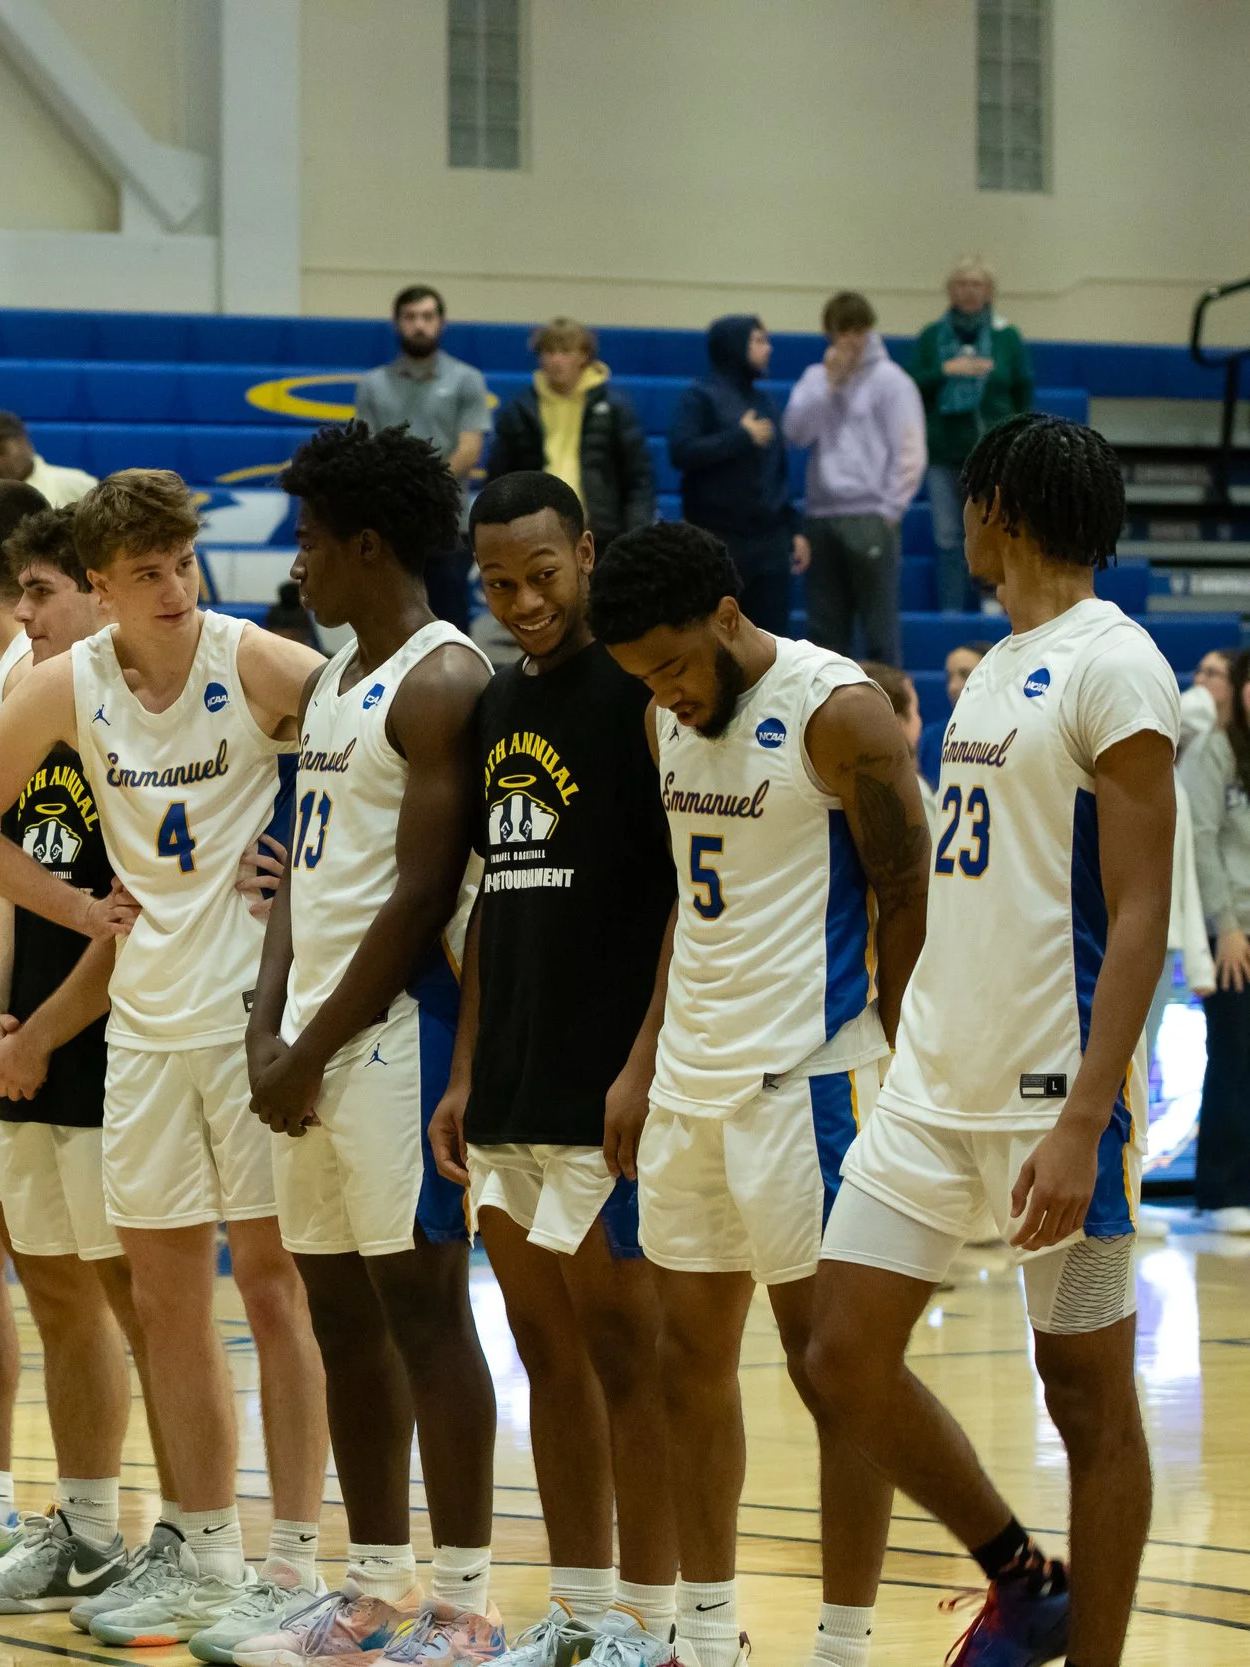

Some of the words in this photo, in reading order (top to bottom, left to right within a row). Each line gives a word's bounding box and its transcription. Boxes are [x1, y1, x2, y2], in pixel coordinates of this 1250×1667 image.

[1025, 680, 1049, 693] NCAA
[106, 738, 229, 787] Emmanuel
[758, 731, 787, 742] NCAA
[942, 722, 1019, 768] Emmanuel
[509, 731, 579, 806] ANNUAL
[661, 771, 769, 819] Emmanuel
[49, 766, 99, 832] ANNUAL
[155, 800, 197, 875] 4
[293, 788, 334, 872] 13
[934, 783, 990, 880] 23
[690, 832, 727, 922] 5
[1052, 1080, 1058, 1091] L
